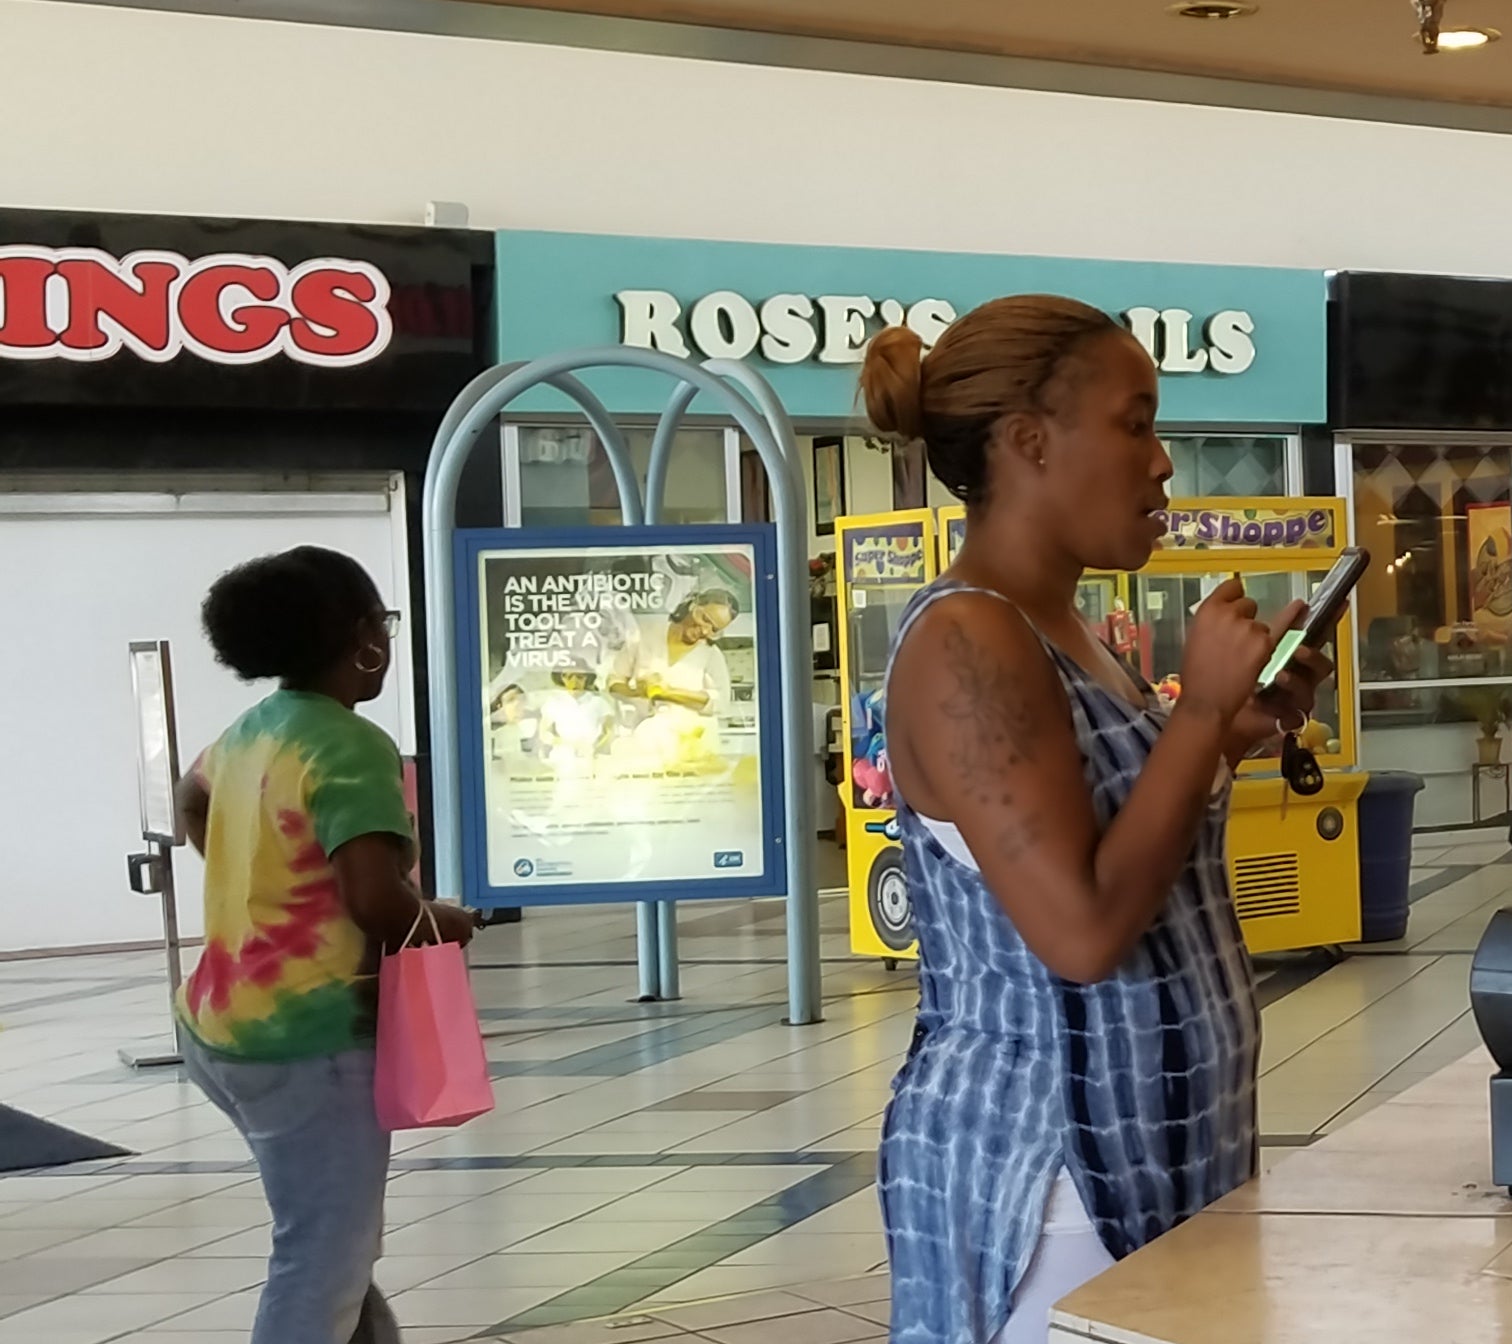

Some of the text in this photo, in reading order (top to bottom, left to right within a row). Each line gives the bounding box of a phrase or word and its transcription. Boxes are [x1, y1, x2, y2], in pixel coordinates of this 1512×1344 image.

[1121, 306, 1256, 375] ILS
[1196, 510, 1328, 546] Shoppe
[504, 572, 665, 594] AN ANTIBIOTIC
[504, 591, 664, 612] IS THE WRONG
[504, 612, 601, 631] TOOL TO
[505, 631, 599, 650] TREAT A
[506, 649, 577, 668] VIRUS.
